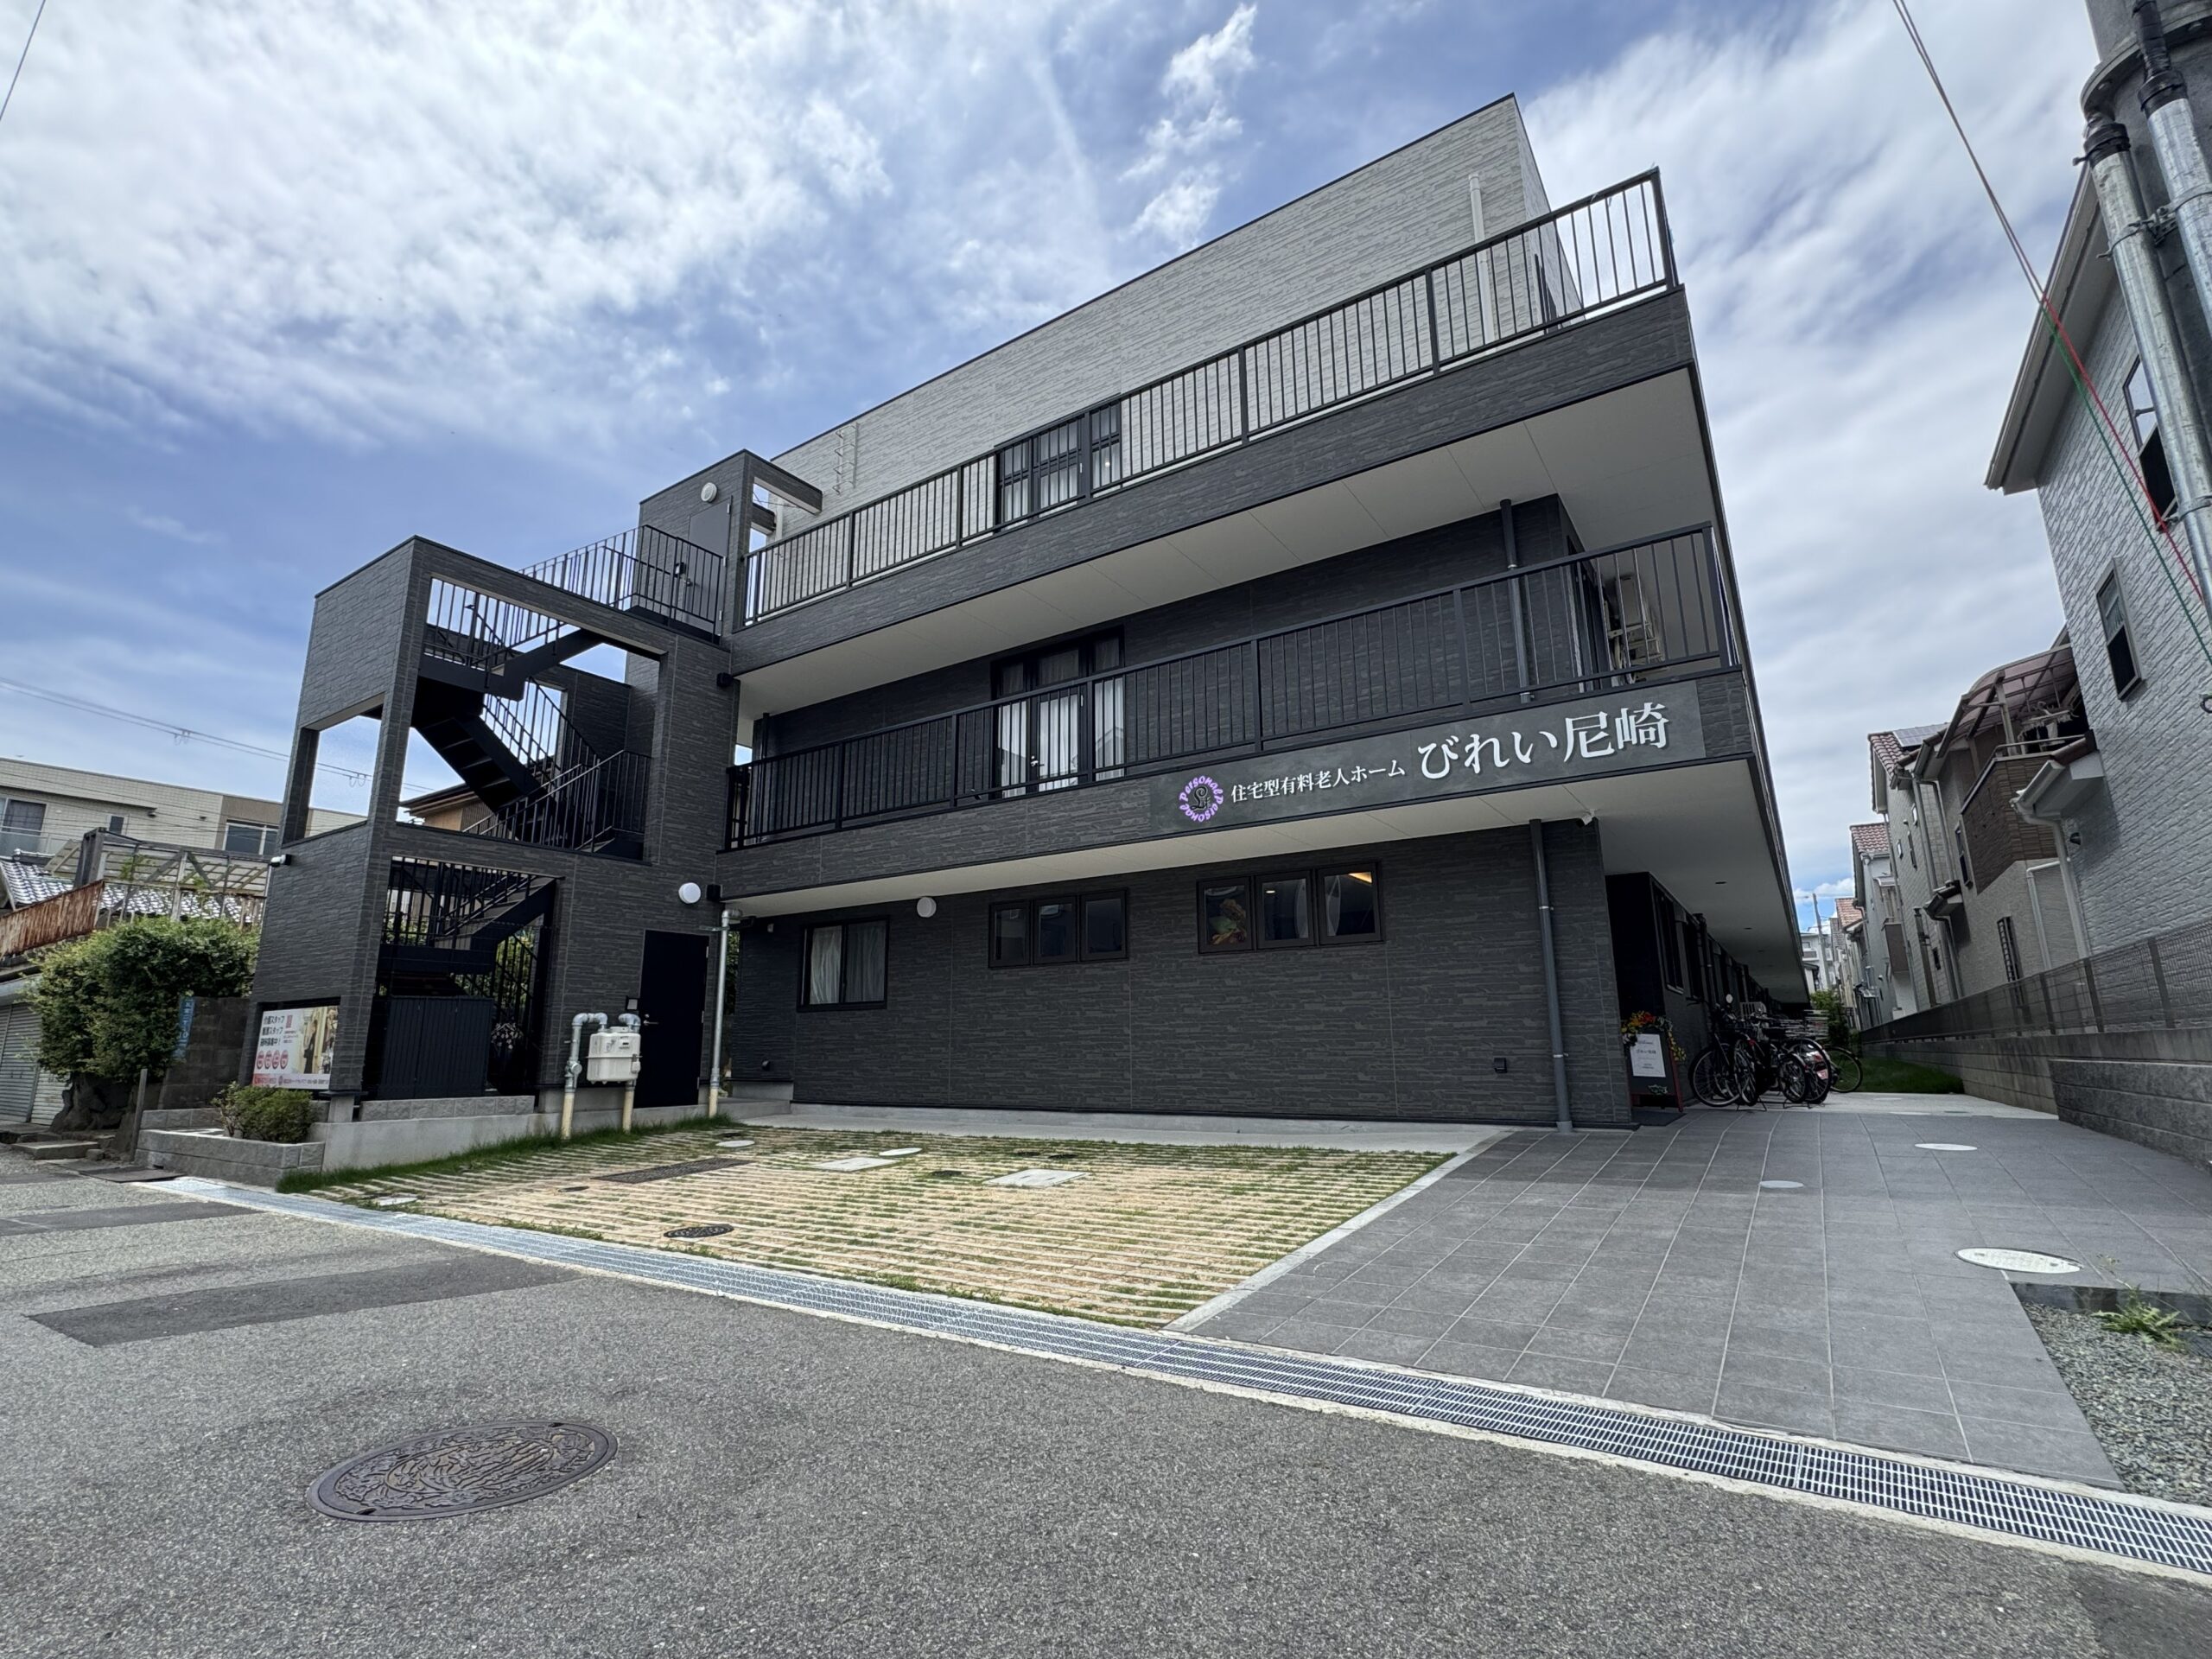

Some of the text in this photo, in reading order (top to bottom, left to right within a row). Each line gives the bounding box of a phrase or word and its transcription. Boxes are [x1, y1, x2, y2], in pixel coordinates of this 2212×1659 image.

[1231, 702, 1669, 804] 住宅型有料老人ホーム びれい尼崎
[1179, 775, 1224, 802] Personal
[1179, 795, 1224, 823] Personal
